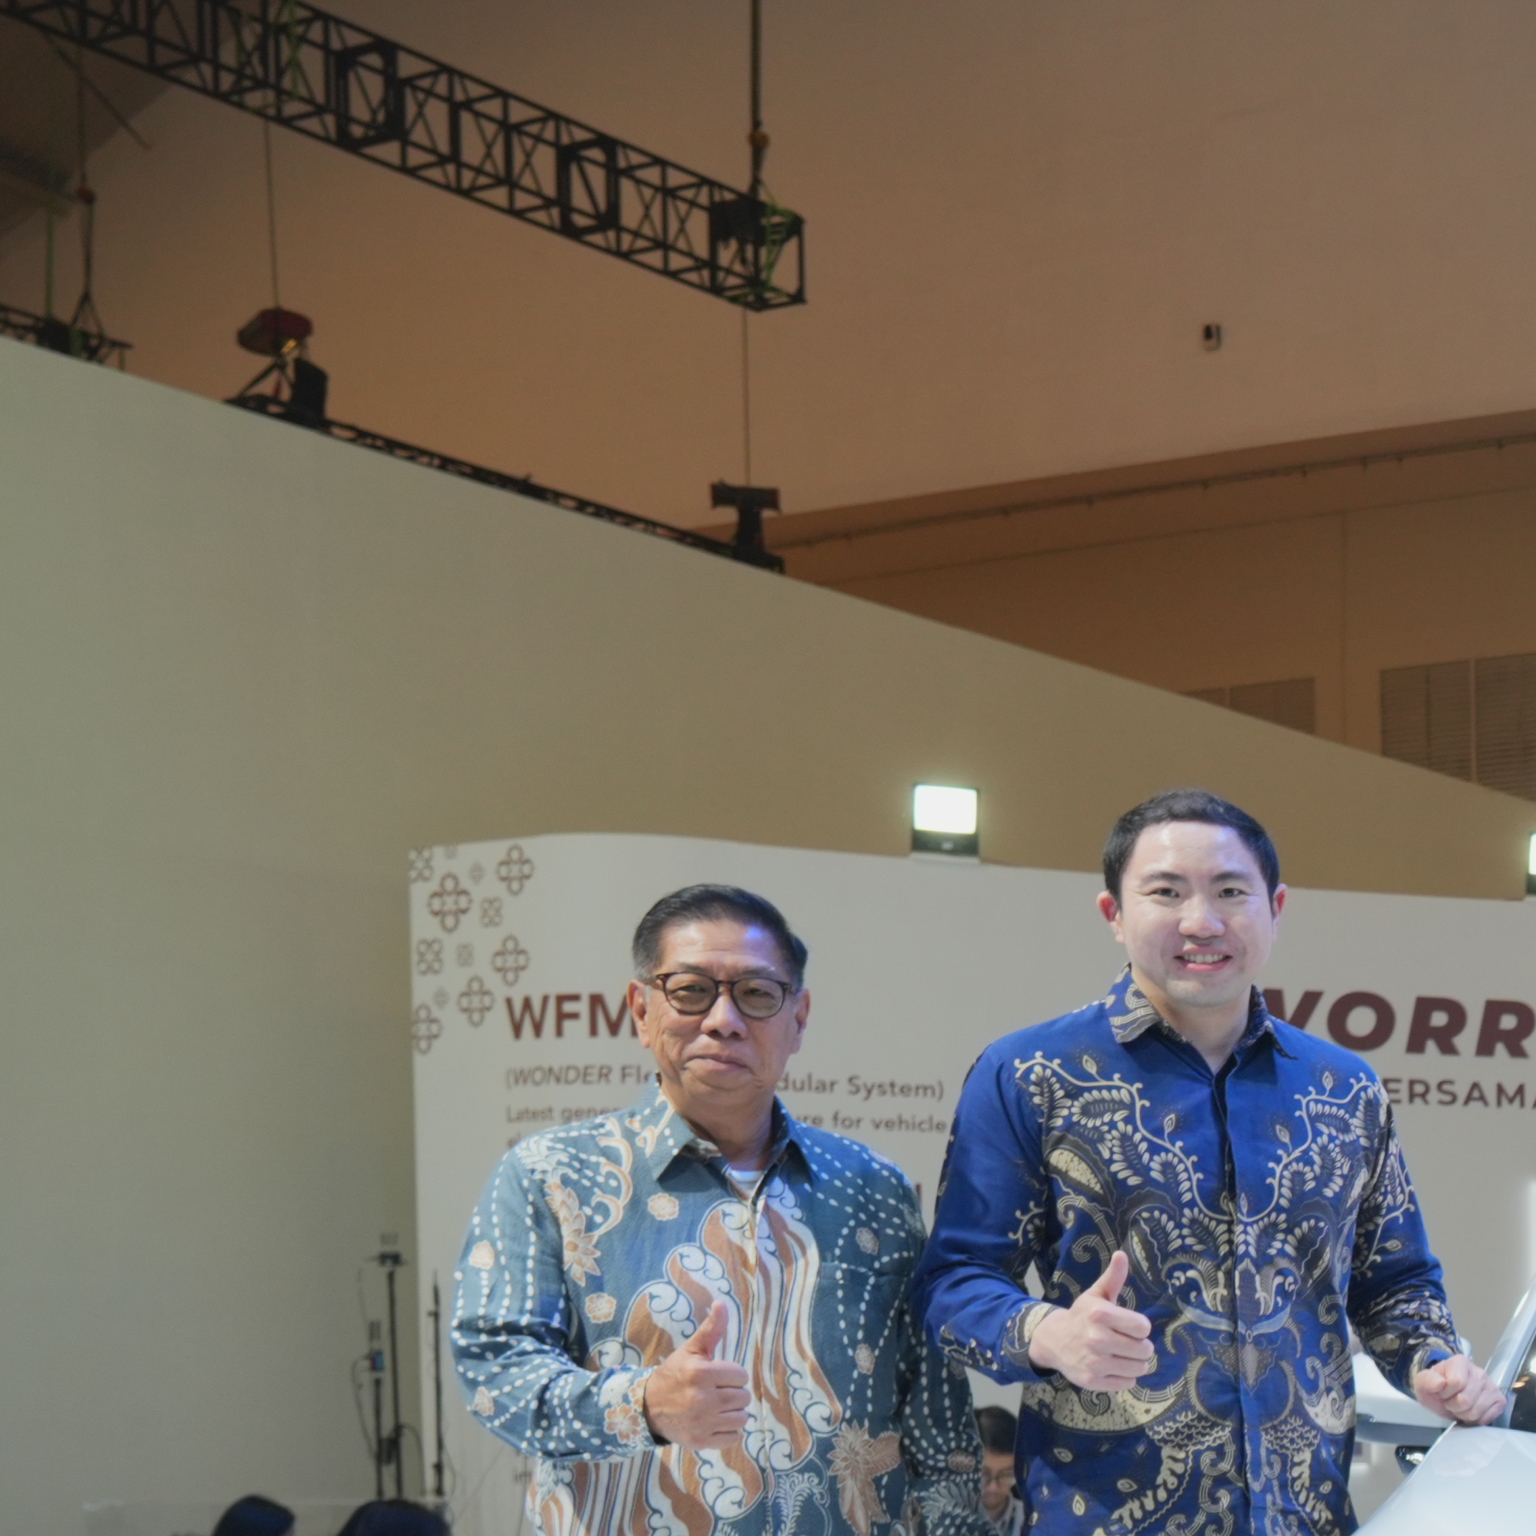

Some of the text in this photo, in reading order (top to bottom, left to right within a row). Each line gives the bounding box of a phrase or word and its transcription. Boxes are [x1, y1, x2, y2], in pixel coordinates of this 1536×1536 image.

[506, 1063, 613, 1089] (WONDER
[848, 1074, 944, 1101] System)
[506, 1105, 553, 1123] Latest
[832, 1110, 862, 1129] for
[870, 1113, 948, 1133] vehicle
